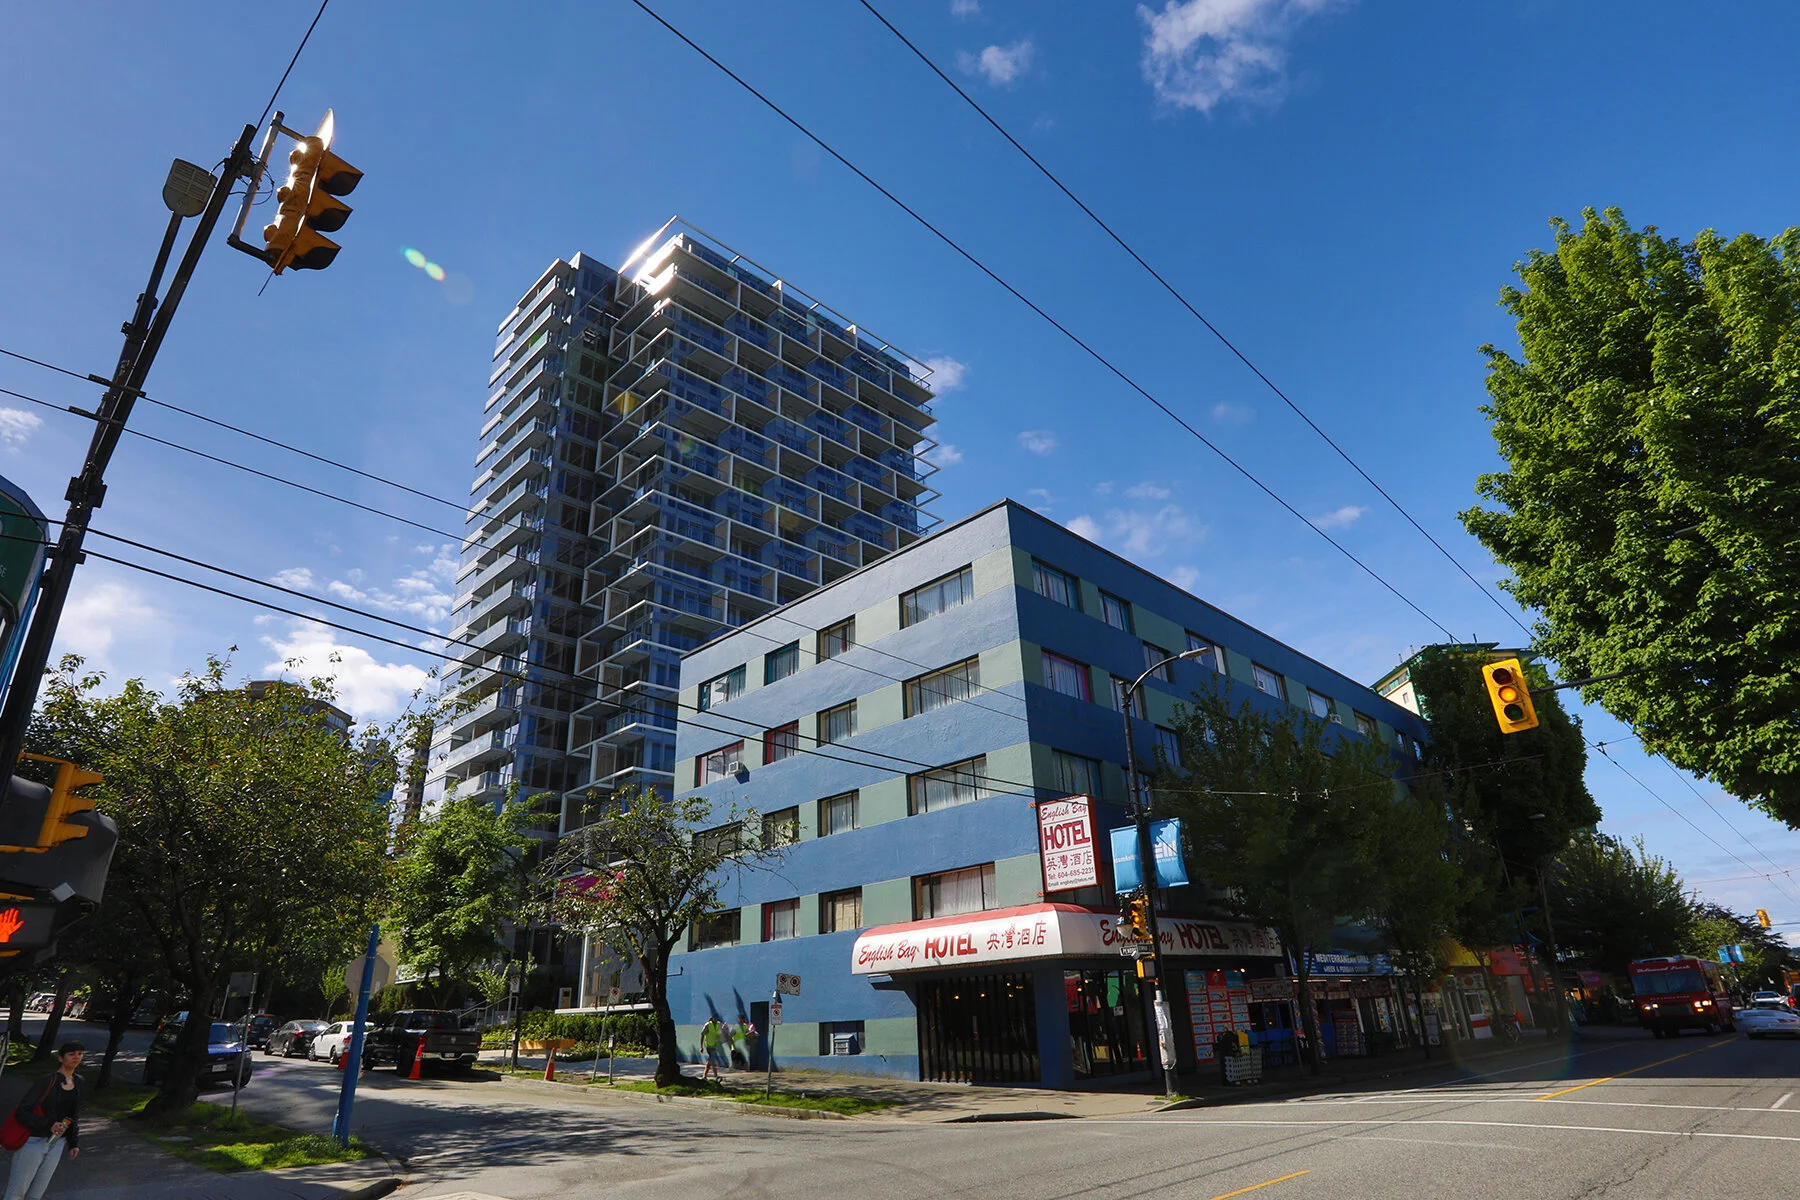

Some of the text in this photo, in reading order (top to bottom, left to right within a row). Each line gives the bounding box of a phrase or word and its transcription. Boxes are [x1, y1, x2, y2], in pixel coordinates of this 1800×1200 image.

[1041, 801, 1087, 821] English Bay
[1044, 820, 1090, 850] HOTEL
[1175, 923, 1229, 949] HOTEL
[858, 932, 978, 969] English Bay HOTEL
